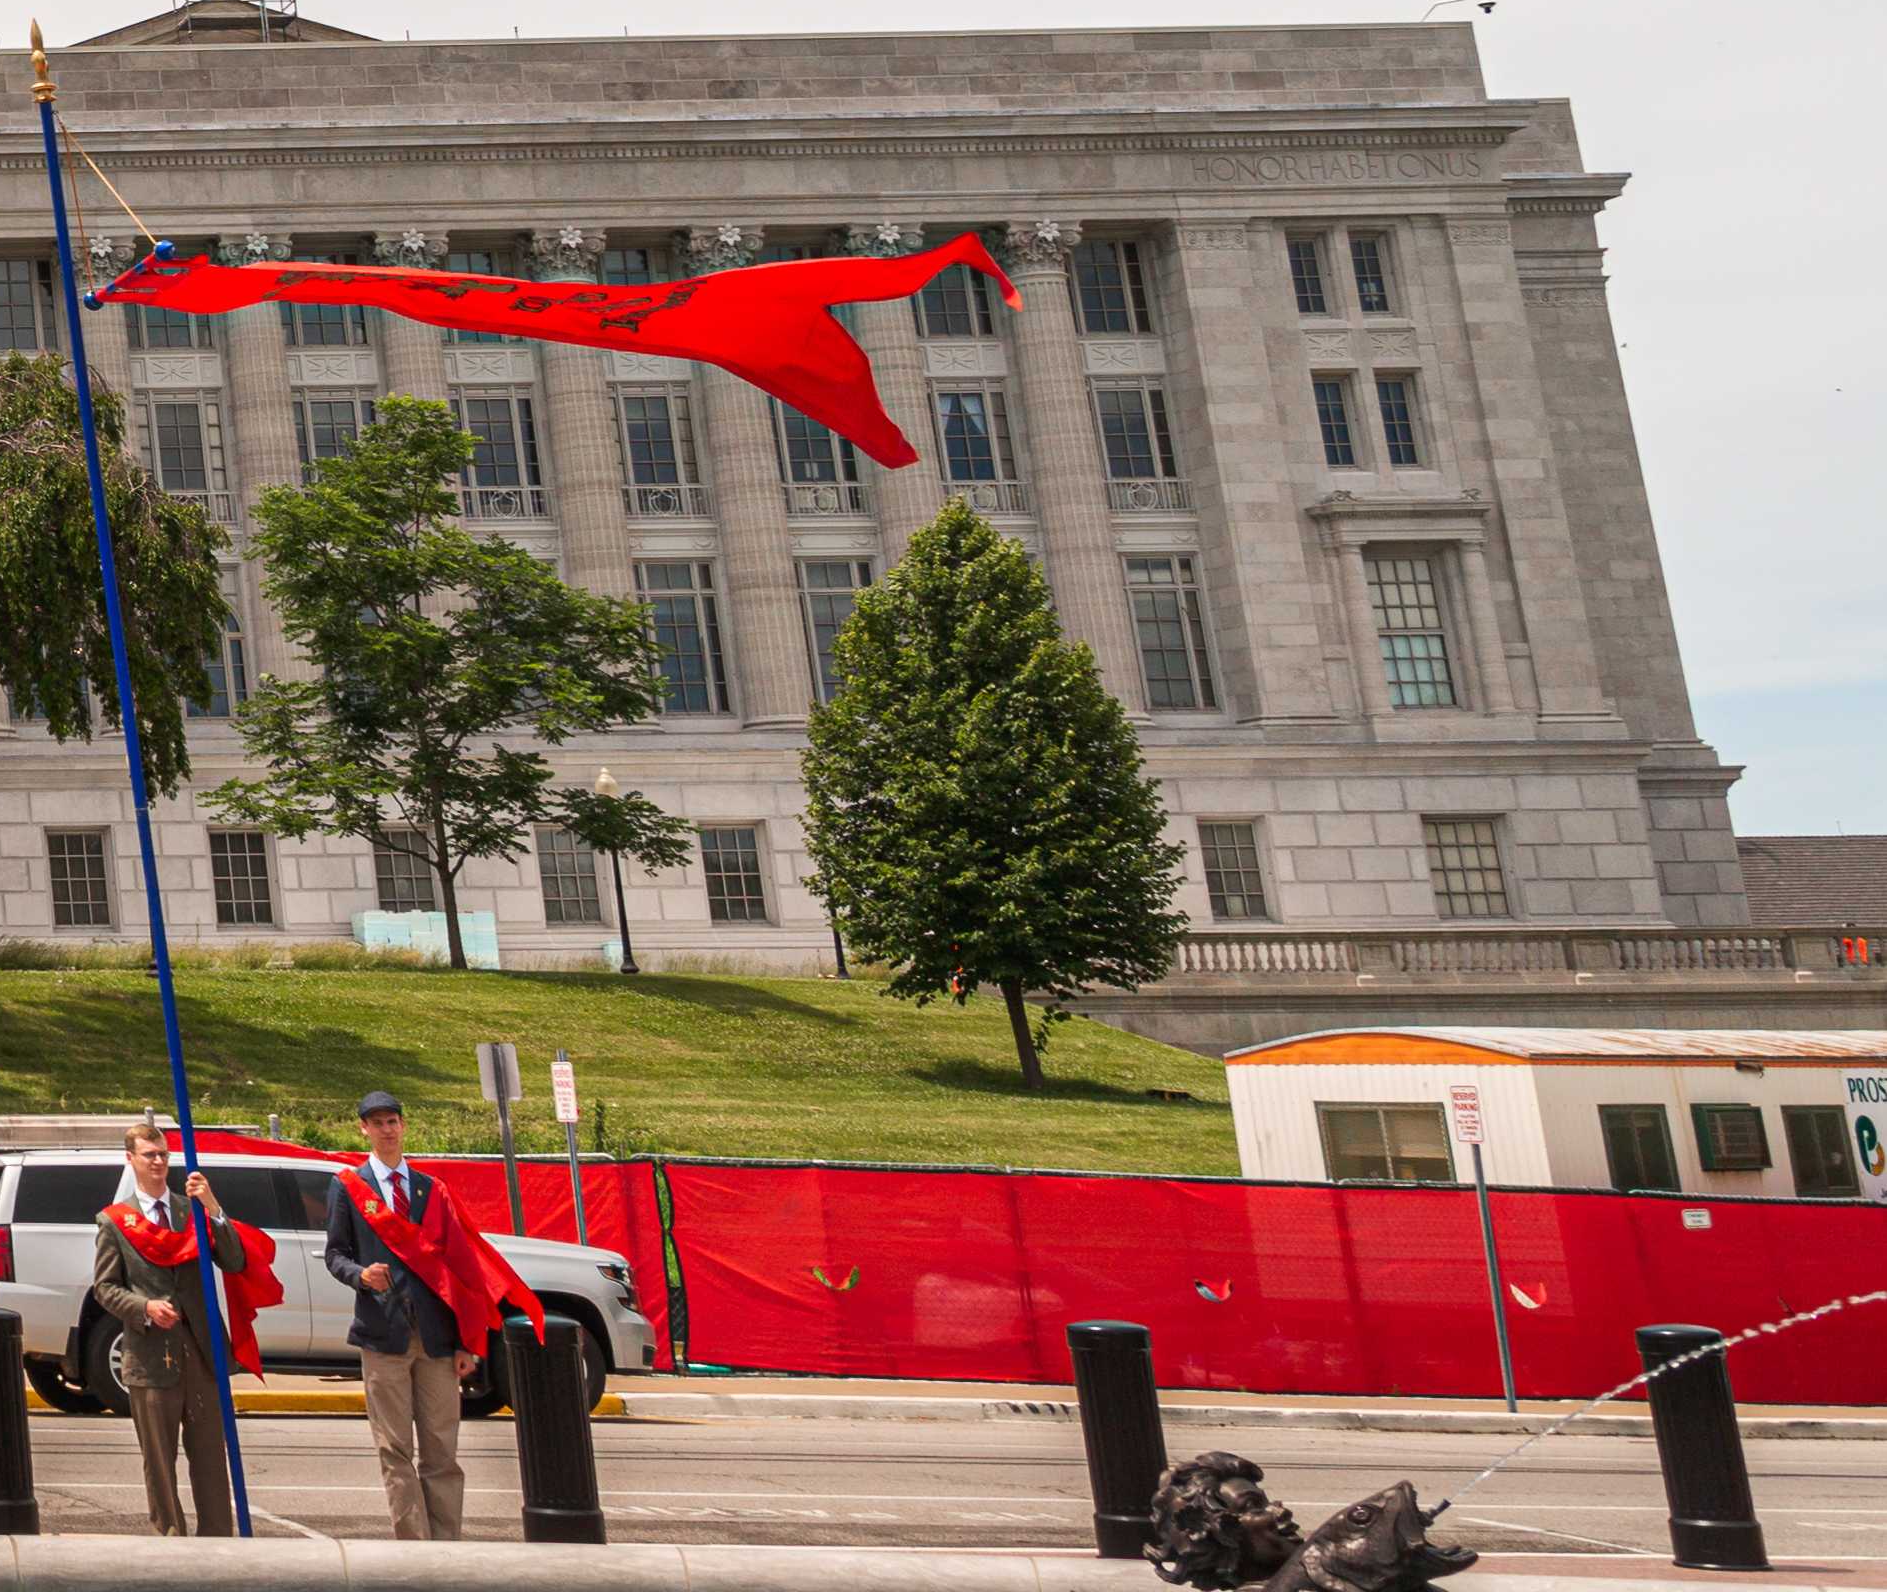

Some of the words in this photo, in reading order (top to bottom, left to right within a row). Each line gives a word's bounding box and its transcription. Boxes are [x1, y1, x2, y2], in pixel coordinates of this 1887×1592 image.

[1190, 155, 1305, 183] HONOR
[1307, 151, 1395, 181] HABET
[1397, 152, 1483, 179] ONUS
